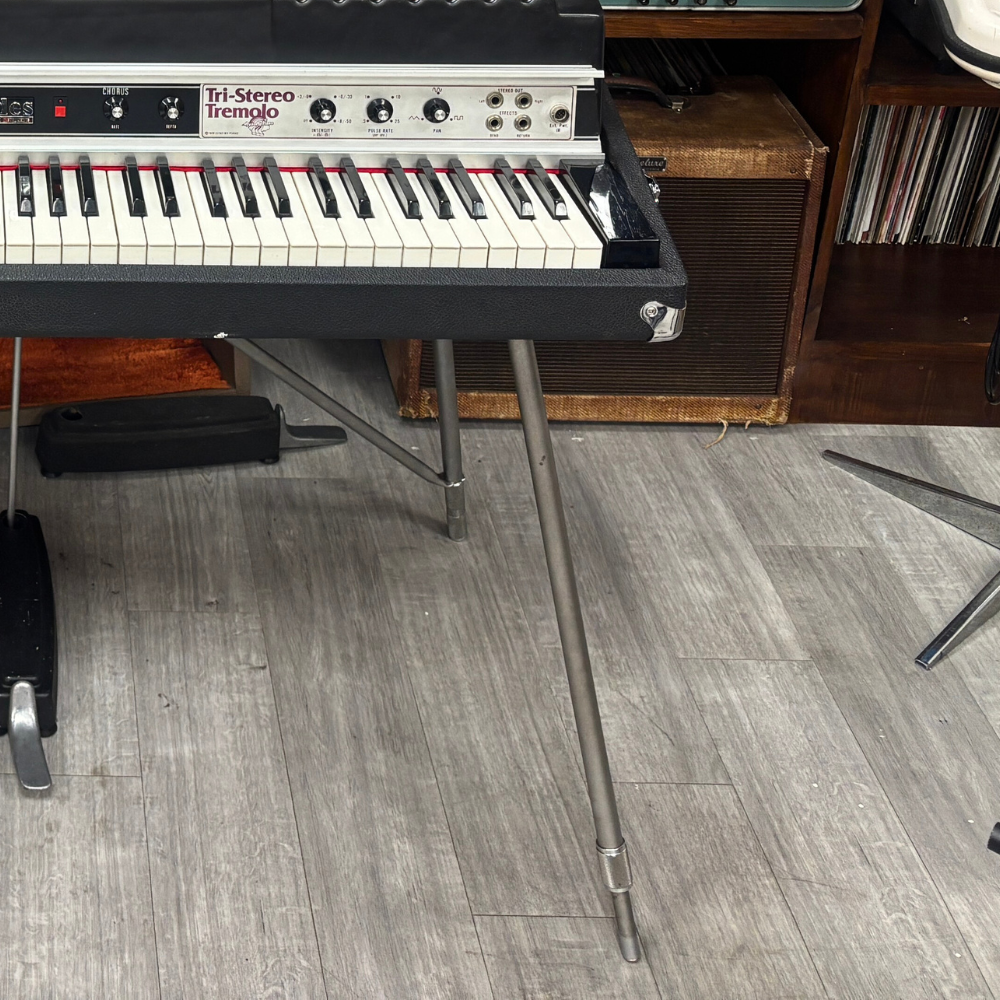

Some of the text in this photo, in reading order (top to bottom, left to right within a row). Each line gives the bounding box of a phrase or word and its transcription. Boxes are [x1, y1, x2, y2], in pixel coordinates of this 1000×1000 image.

[102, 87, 129, 96] CHORUS
[205, 87, 295, 103] Tri-Stereo
[205, 104, 279, 118] Tremolo
